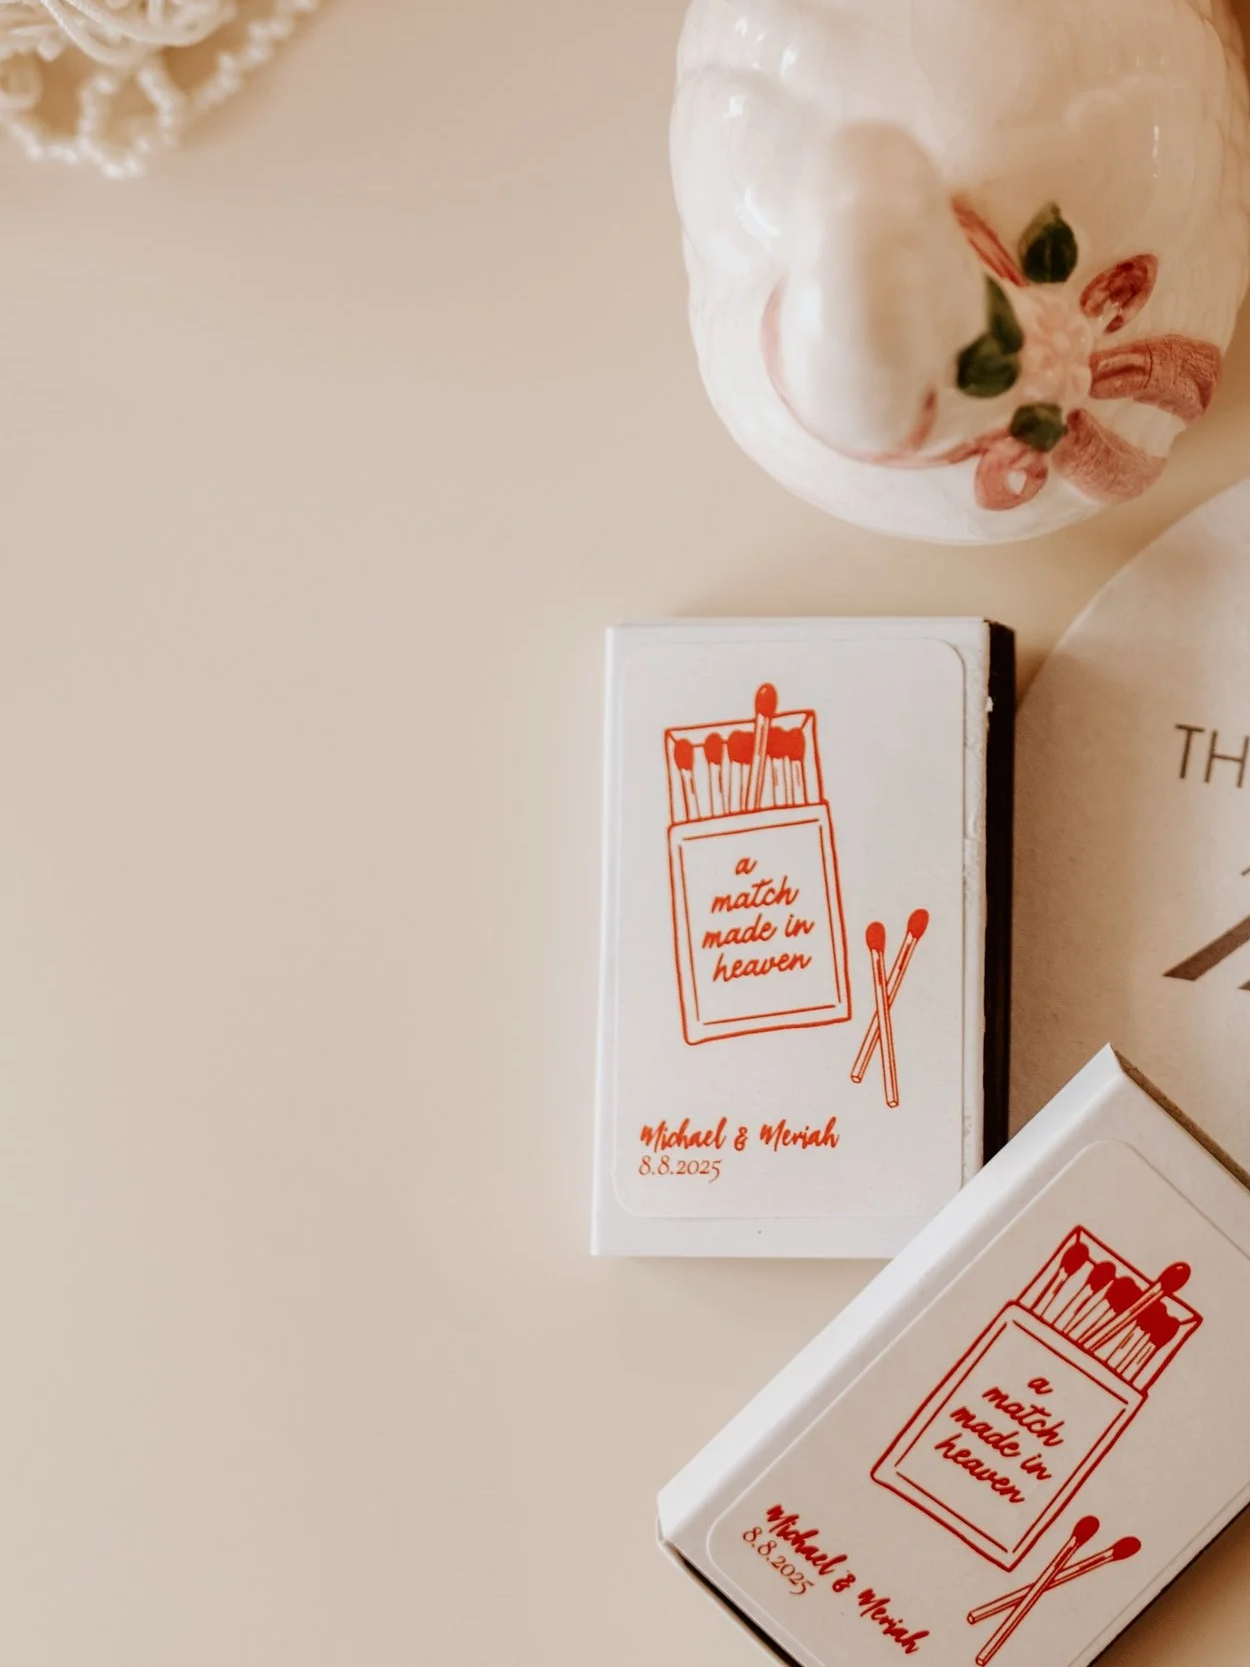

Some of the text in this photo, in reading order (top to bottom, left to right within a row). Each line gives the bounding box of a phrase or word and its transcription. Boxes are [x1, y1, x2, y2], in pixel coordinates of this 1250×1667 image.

[734, 857, 758, 875] a
[710, 875, 800, 914] match
[702, 913, 815, 949] made in
[712, 952, 812, 983] heaven
[640, 1116, 840, 1153] Michael & Meriah
[638, 1154, 723, 1184] 8.8.2025
[1027, 1377, 1053, 1395] a
[981, 1386, 1065, 1447] match
[949, 1406, 1053, 1481] made in
[934, 1432, 1025, 1503] heaven
[742, 1526, 815, 1596] 8.8.2025
[766, 1504, 930, 1654] Michael & Meriah
